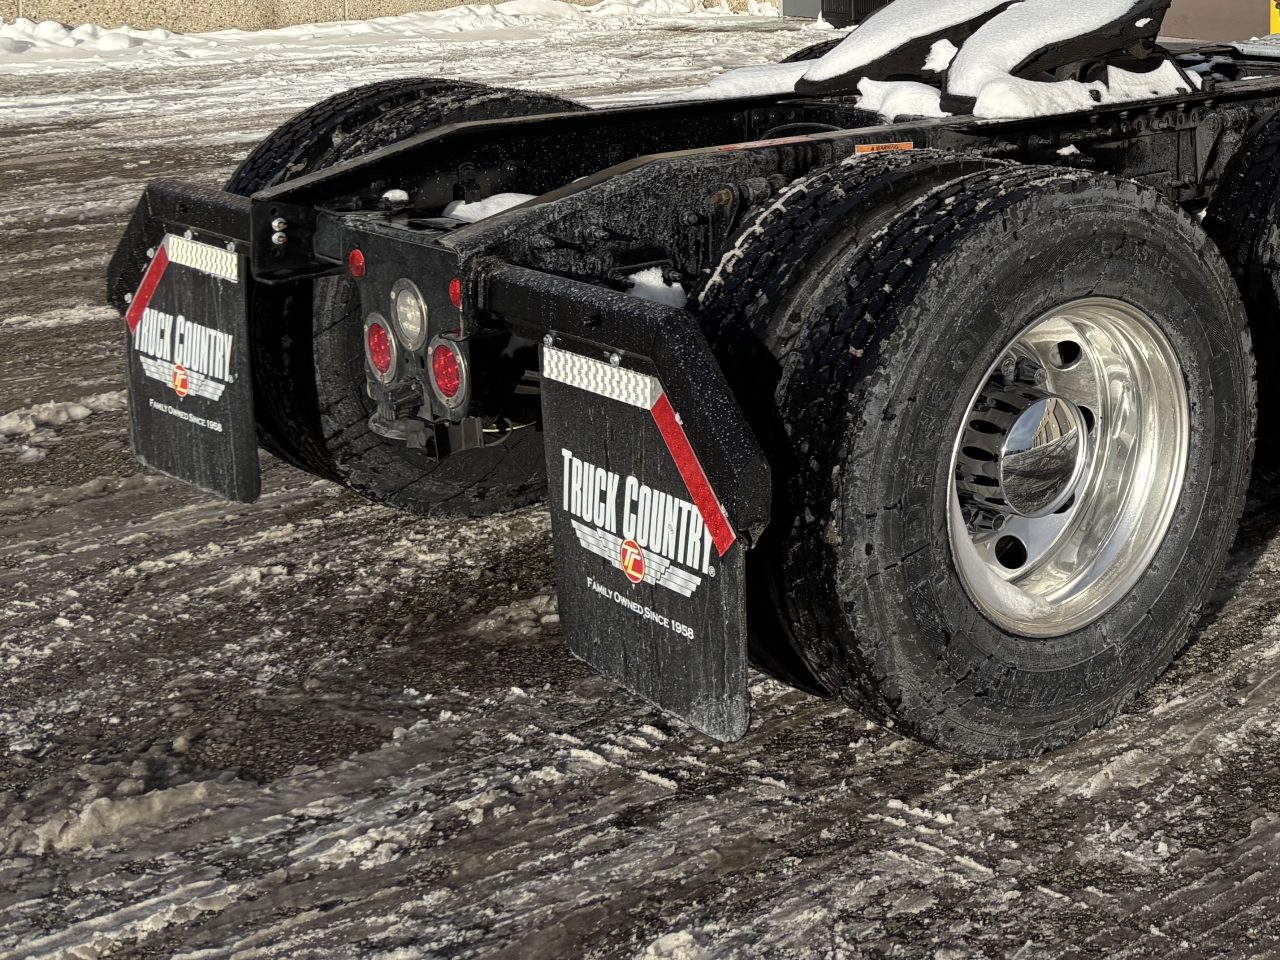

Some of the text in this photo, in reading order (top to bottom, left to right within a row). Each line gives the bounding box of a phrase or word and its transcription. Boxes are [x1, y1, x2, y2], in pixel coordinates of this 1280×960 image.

[174, 314, 234, 382] COUNTRY
[148, 398, 168, 413] FAMILY
[168, 406, 189, 420] OWNED
[188, 413, 206, 427] SINCE
[562, 447, 713, 575] TRUCK COUNTRY
[587, 576, 694, 640] FAMILY OWNED SINCE 1958
